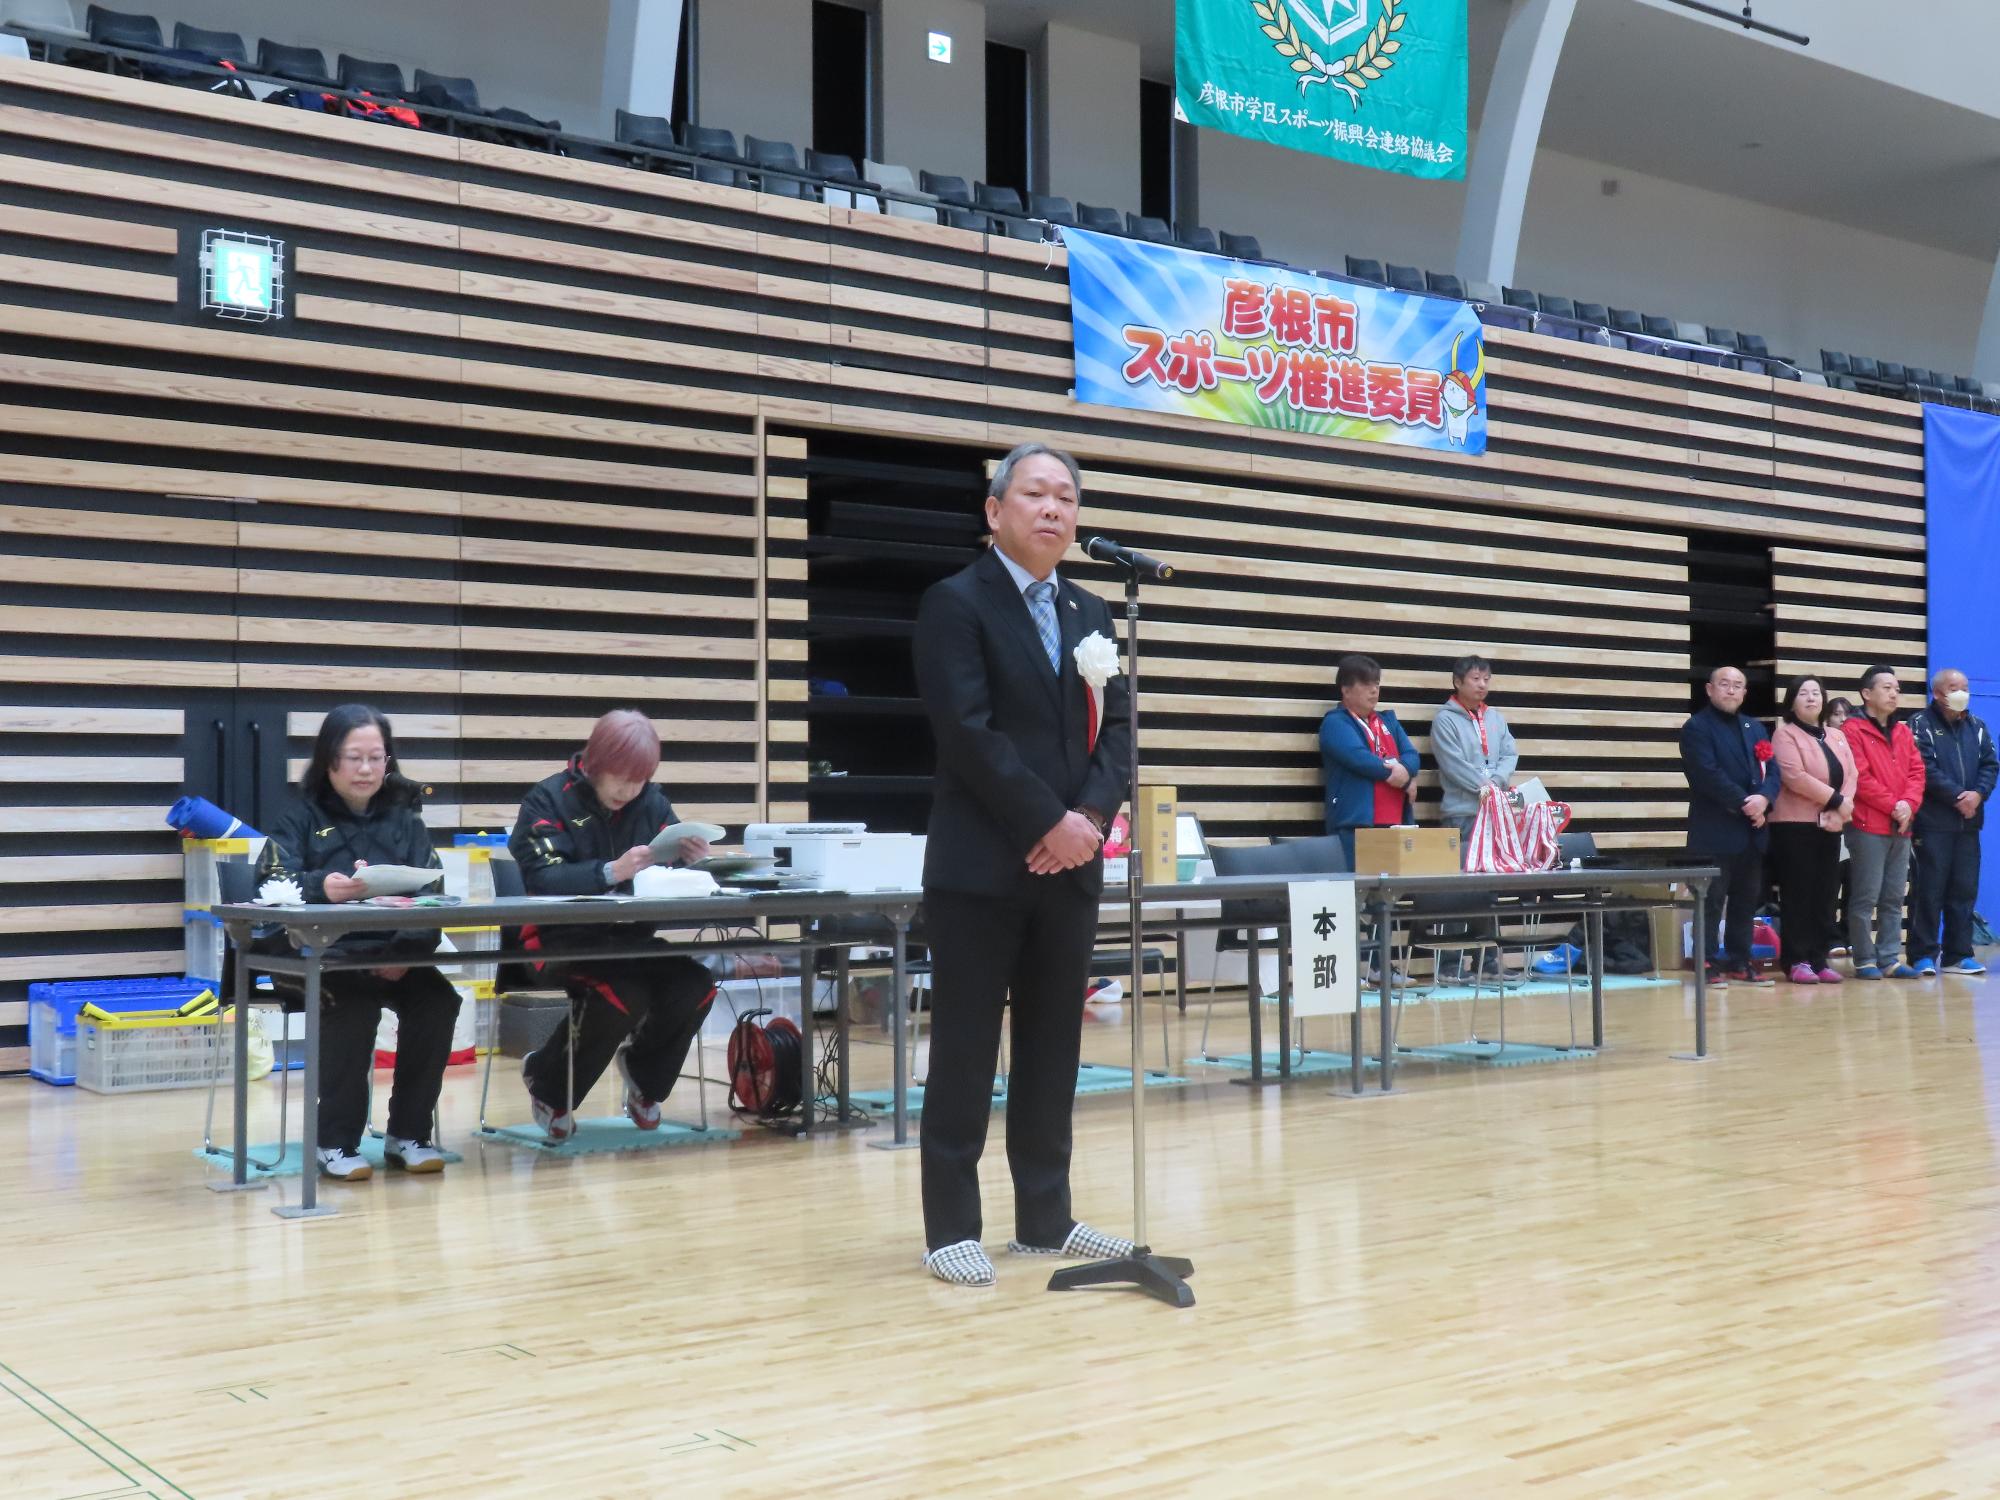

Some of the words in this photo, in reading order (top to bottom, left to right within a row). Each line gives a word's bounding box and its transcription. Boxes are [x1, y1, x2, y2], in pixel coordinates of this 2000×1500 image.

[1197, 81, 1455, 163] 彦根市学区スポーツ振興会連絡協議会
[1222, 278, 1357, 351] 彦根市
[1124, 327, 1444, 425] スポーツ推進委員
[1312, 906, 1337, 989] 本部
